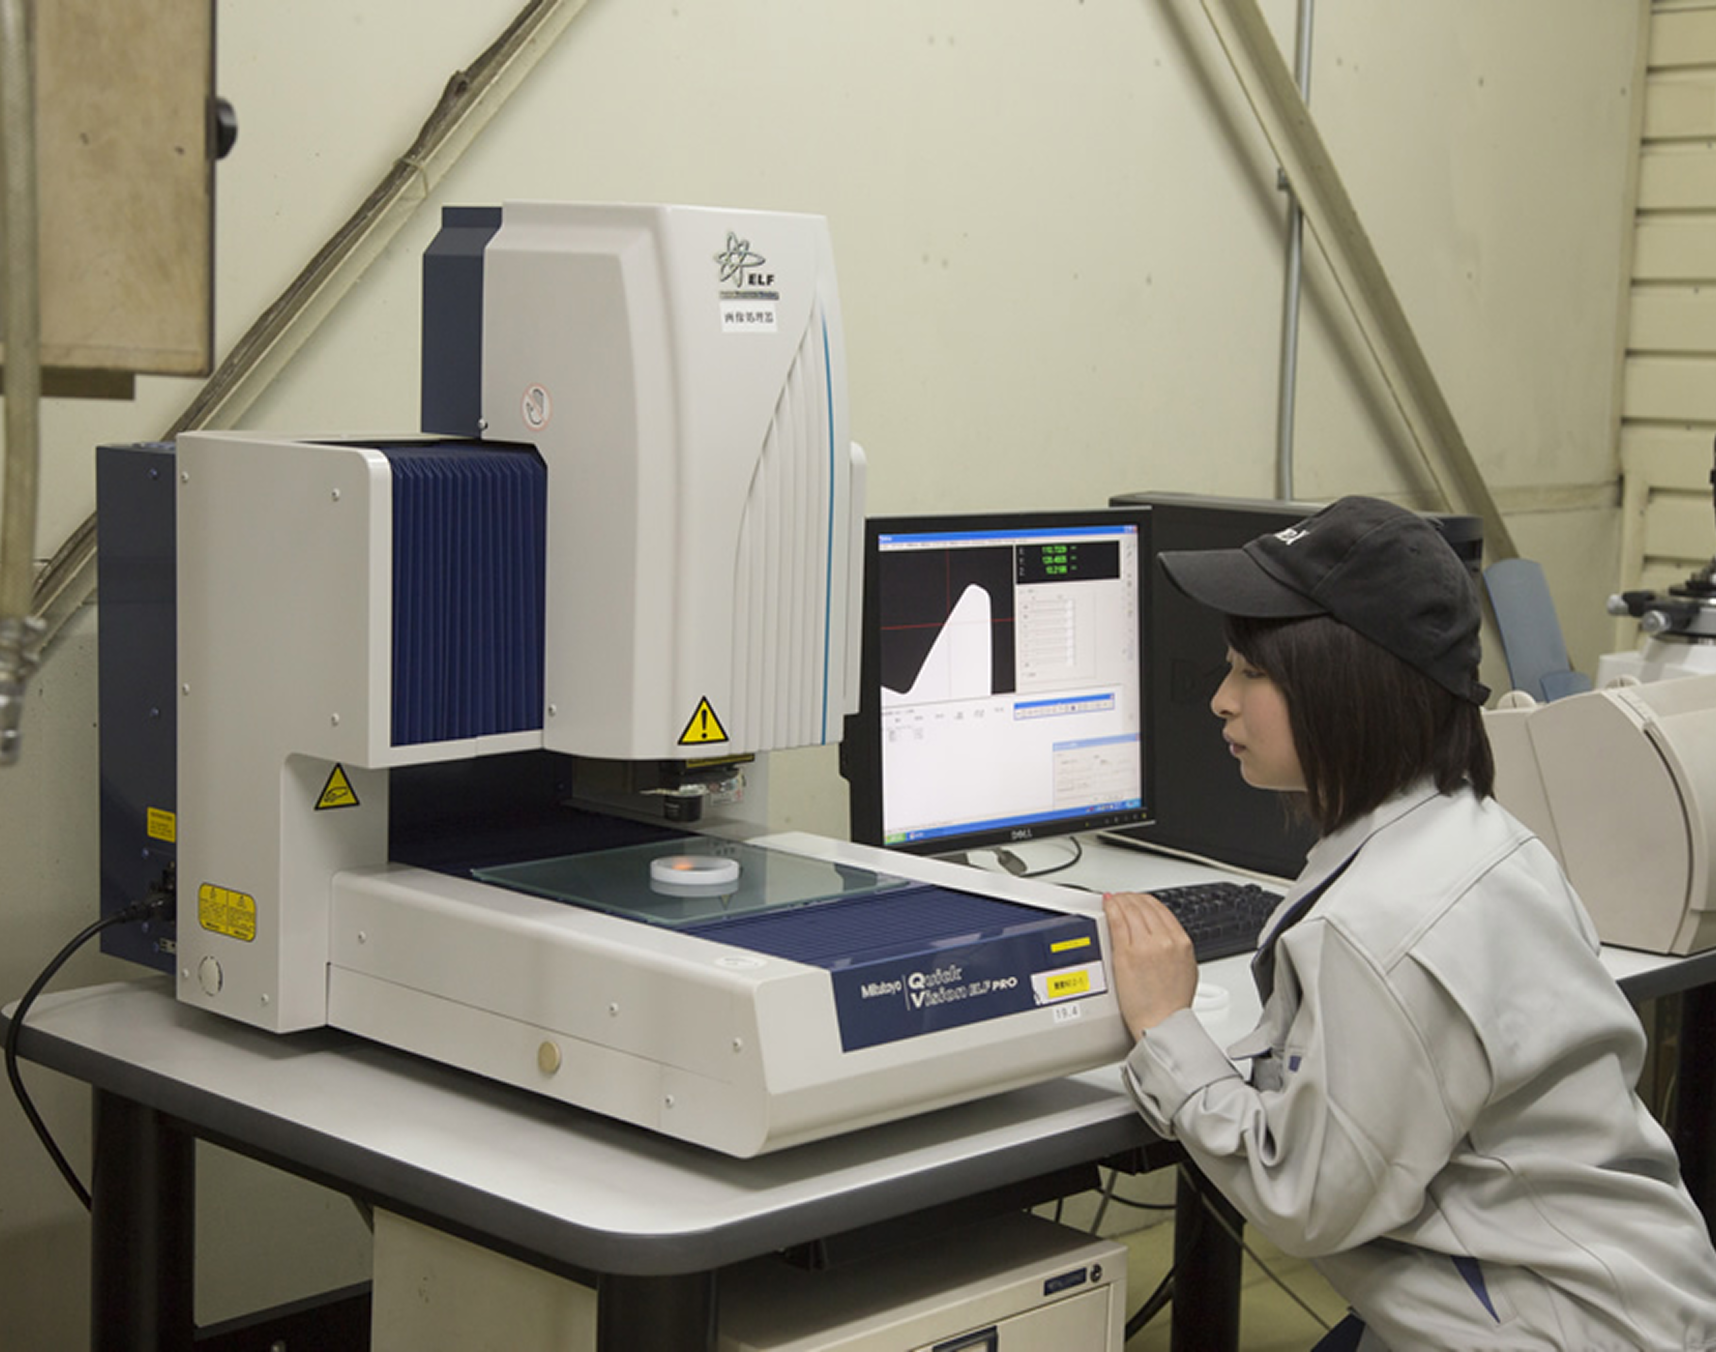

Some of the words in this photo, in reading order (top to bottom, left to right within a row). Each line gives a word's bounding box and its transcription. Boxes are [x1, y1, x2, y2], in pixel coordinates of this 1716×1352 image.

[748, 273, 774, 286] ELF
[908, 965, 962, 989] Quick
[911, 984, 967, 1008] Vision
[992, 976, 1018, 991] PRO
